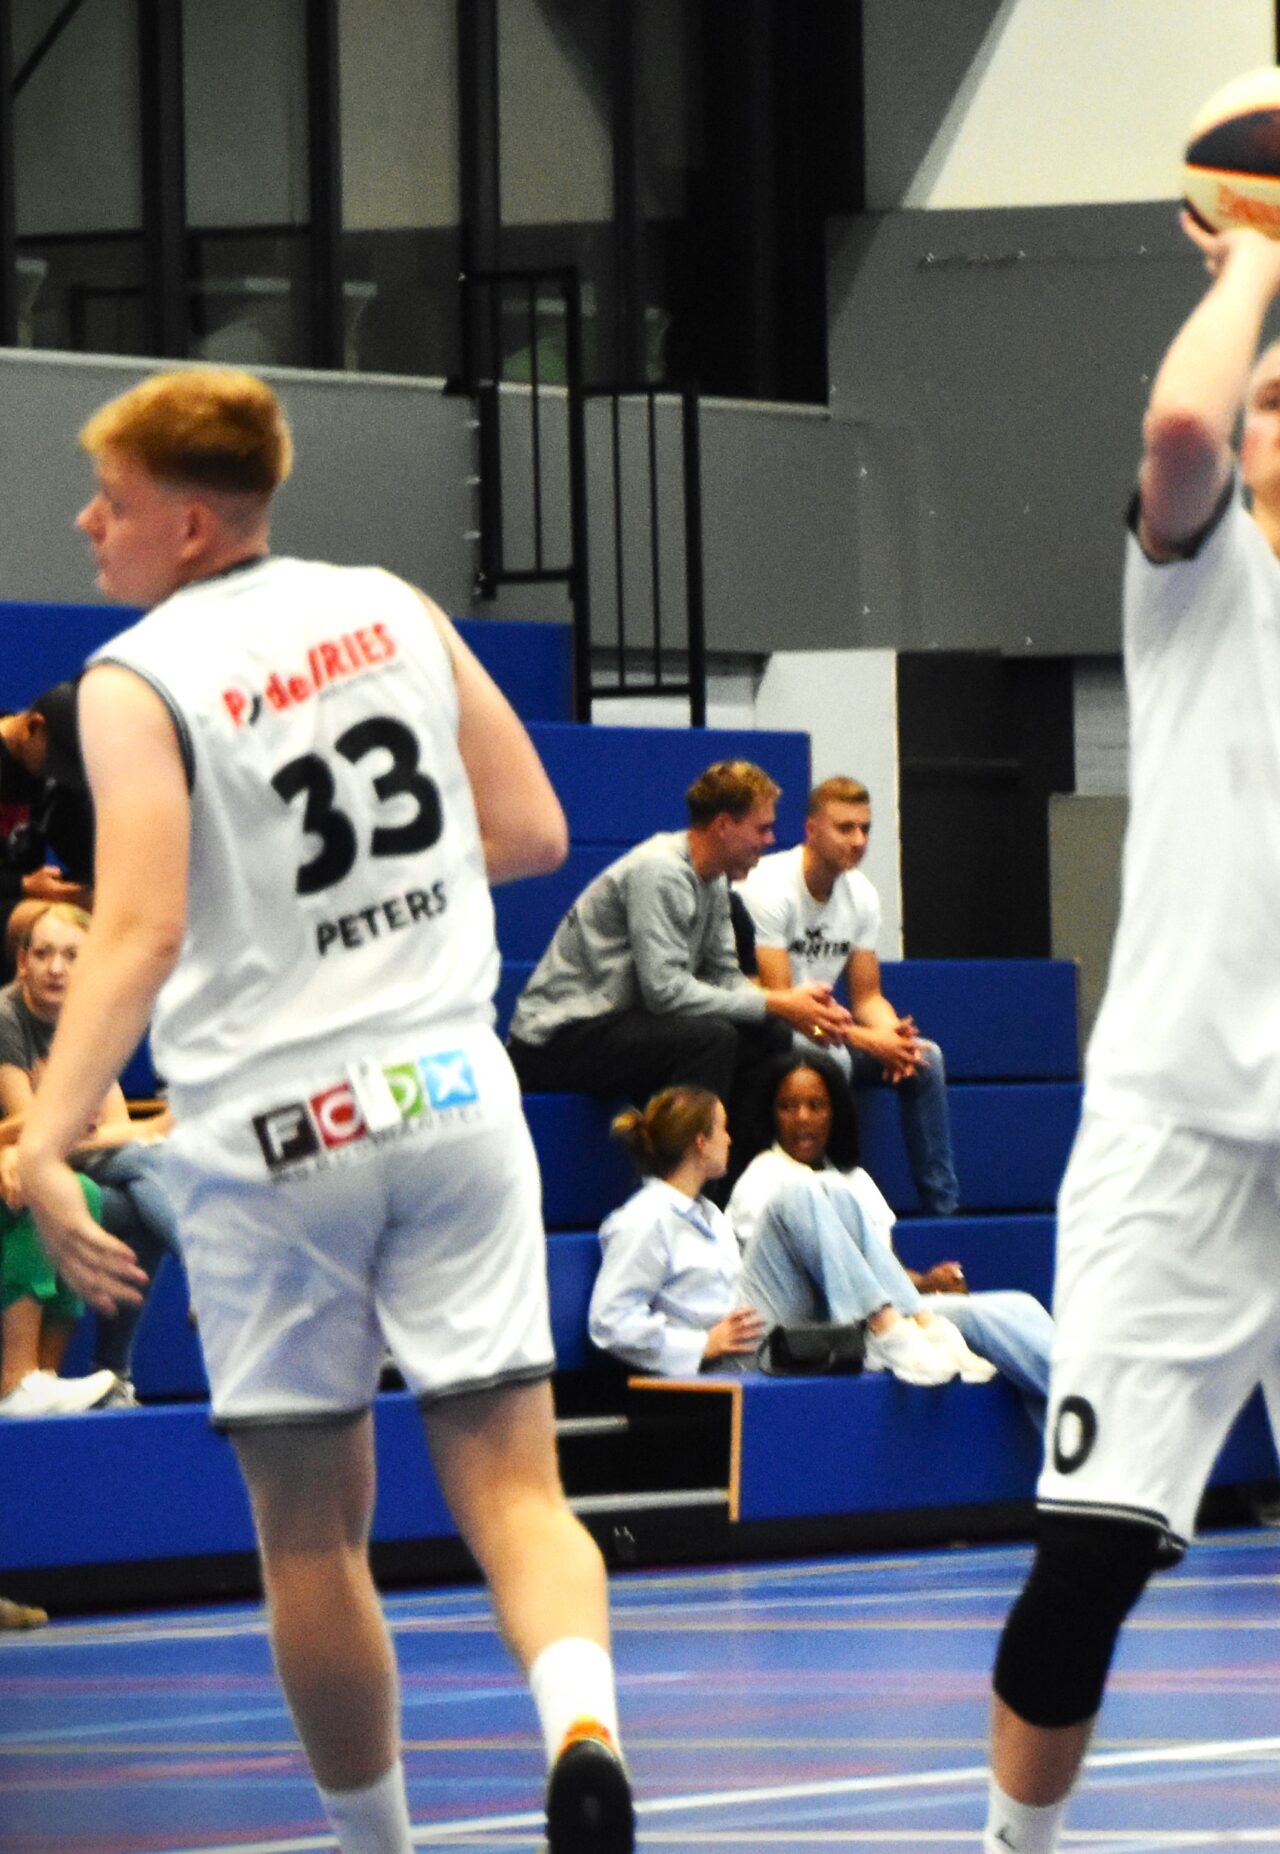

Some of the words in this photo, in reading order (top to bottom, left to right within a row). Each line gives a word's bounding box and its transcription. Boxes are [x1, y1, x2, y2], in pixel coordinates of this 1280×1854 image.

[271, 716, 443, 895] 33
[316, 880, 447, 956] PETERS
[1053, 1395, 1097, 1474] 0
